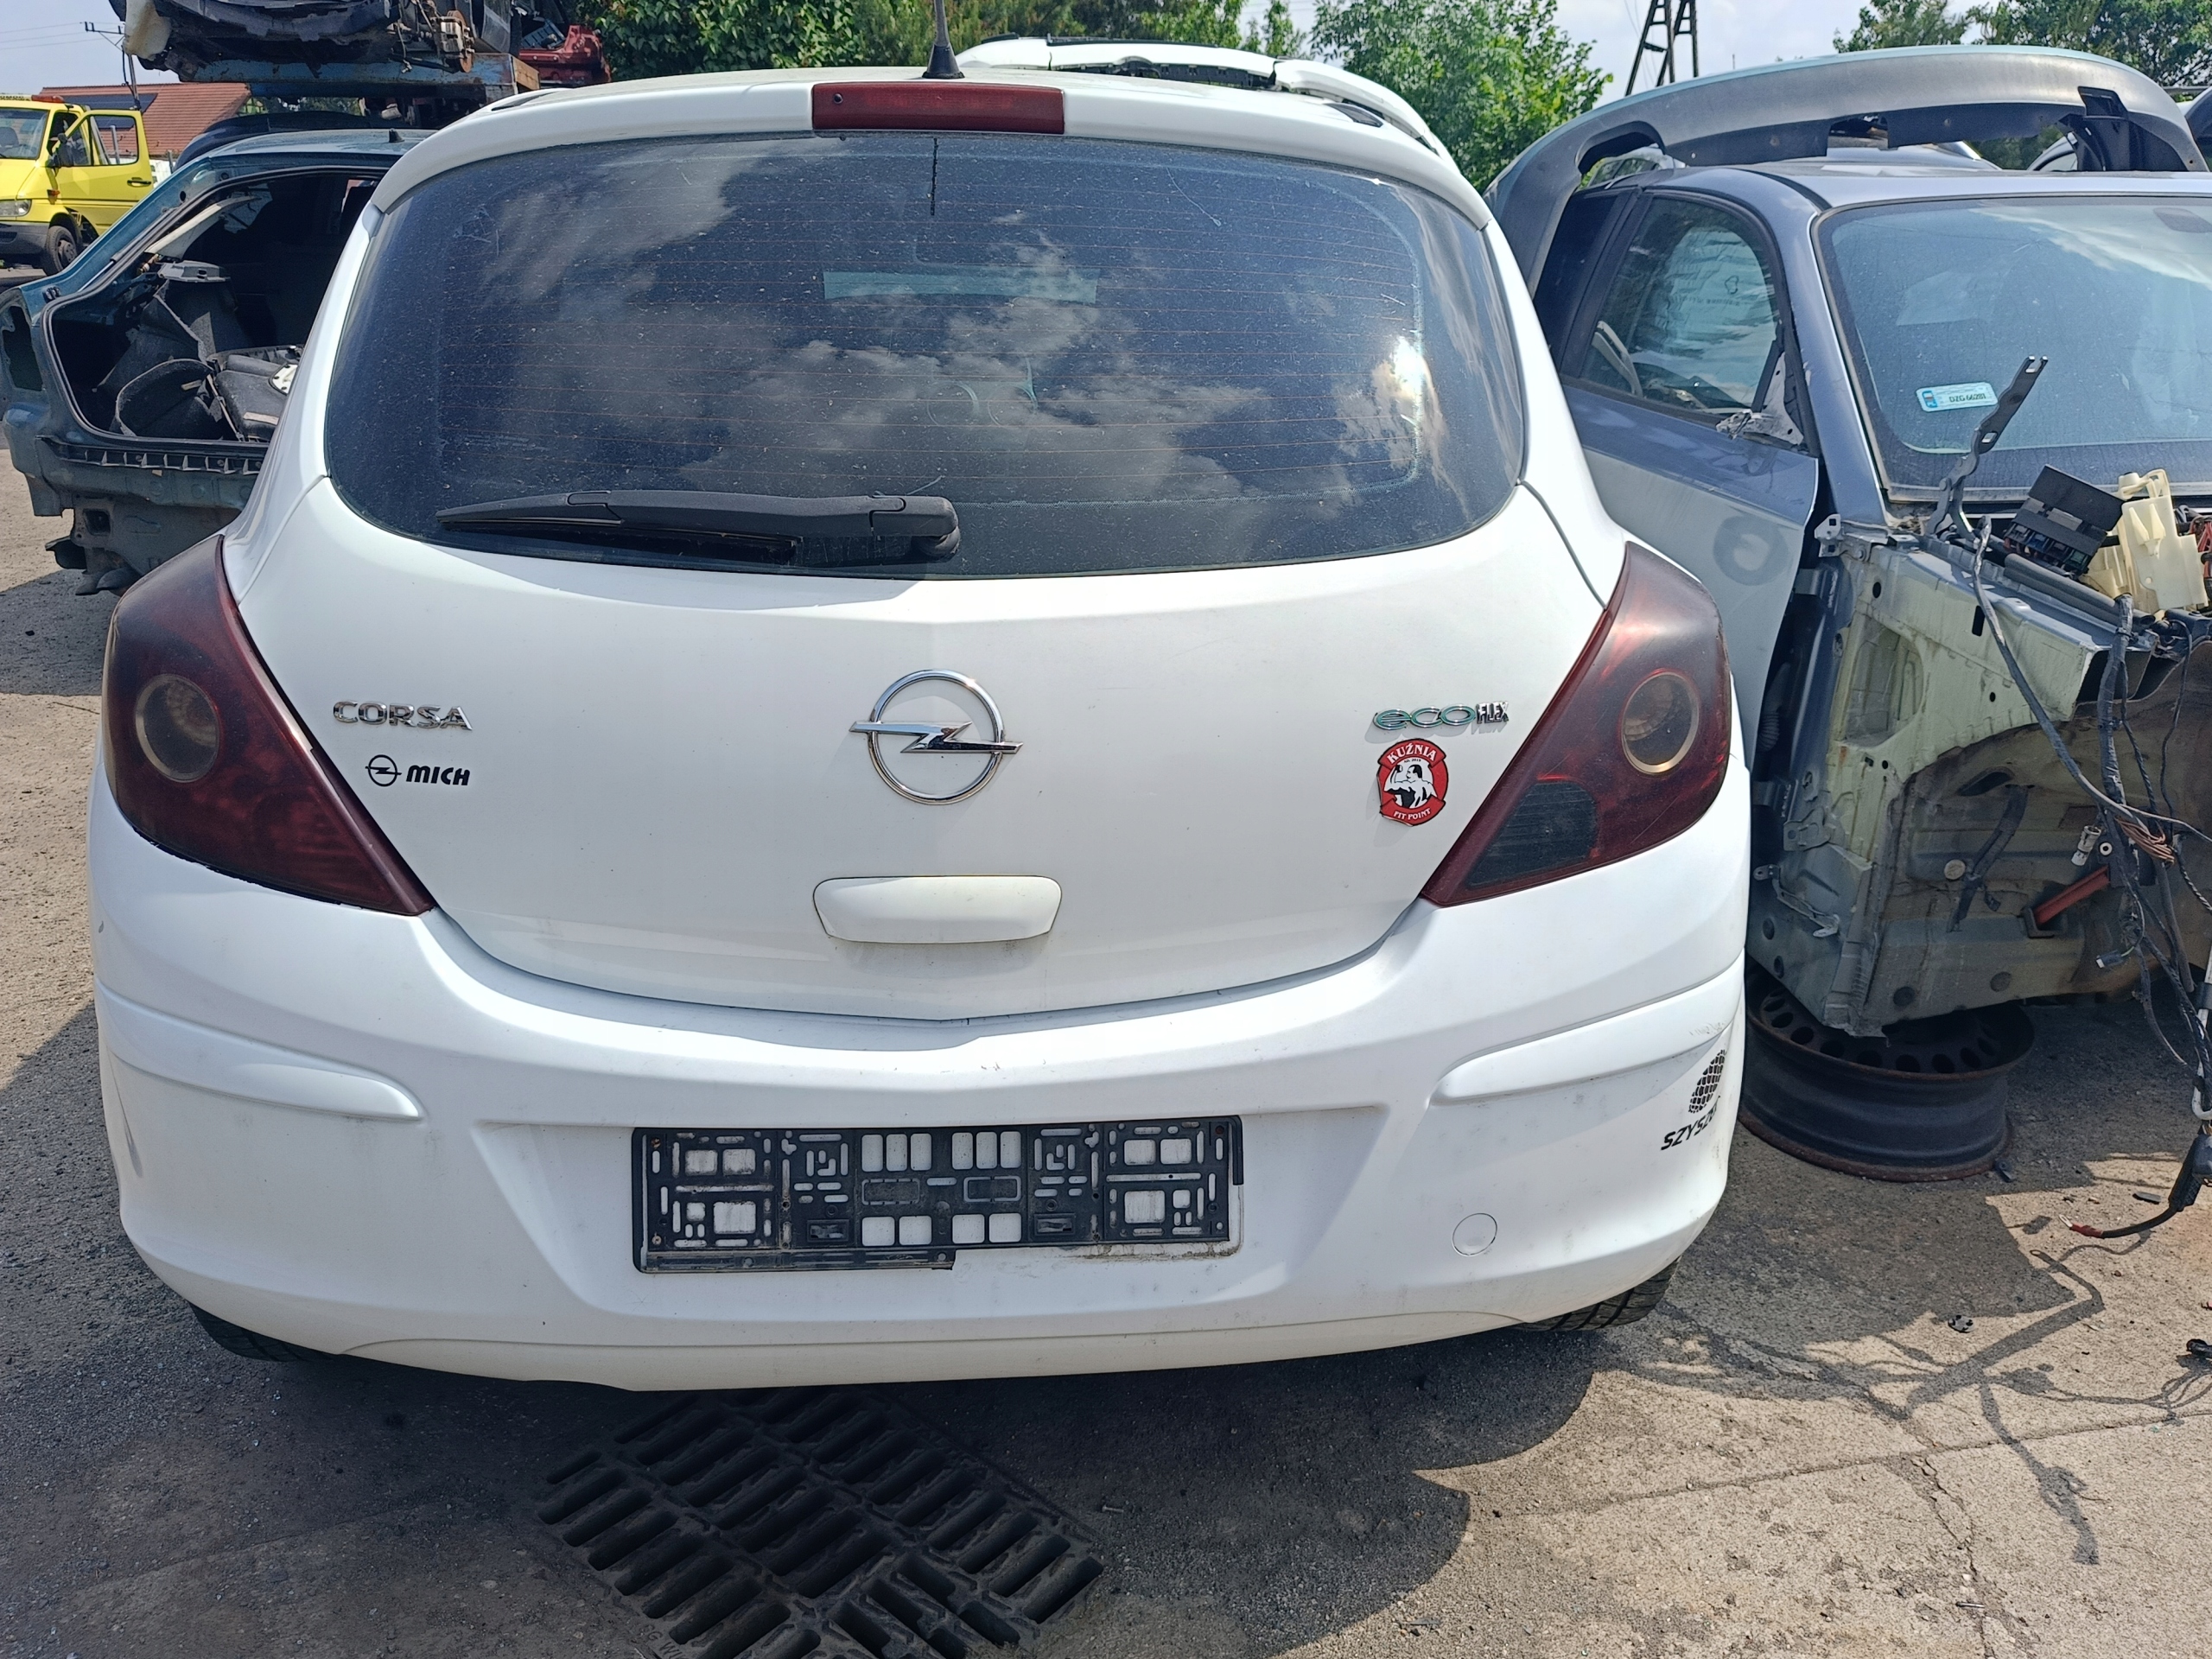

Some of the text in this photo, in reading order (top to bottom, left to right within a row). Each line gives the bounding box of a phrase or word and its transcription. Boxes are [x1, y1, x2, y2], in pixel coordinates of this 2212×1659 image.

[333, 700, 473, 731] CORSA
[1387, 742, 1437, 765] KUŹNIA
[405, 764, 471, 785] MICH
[1408, 808, 1431, 820] POINT
